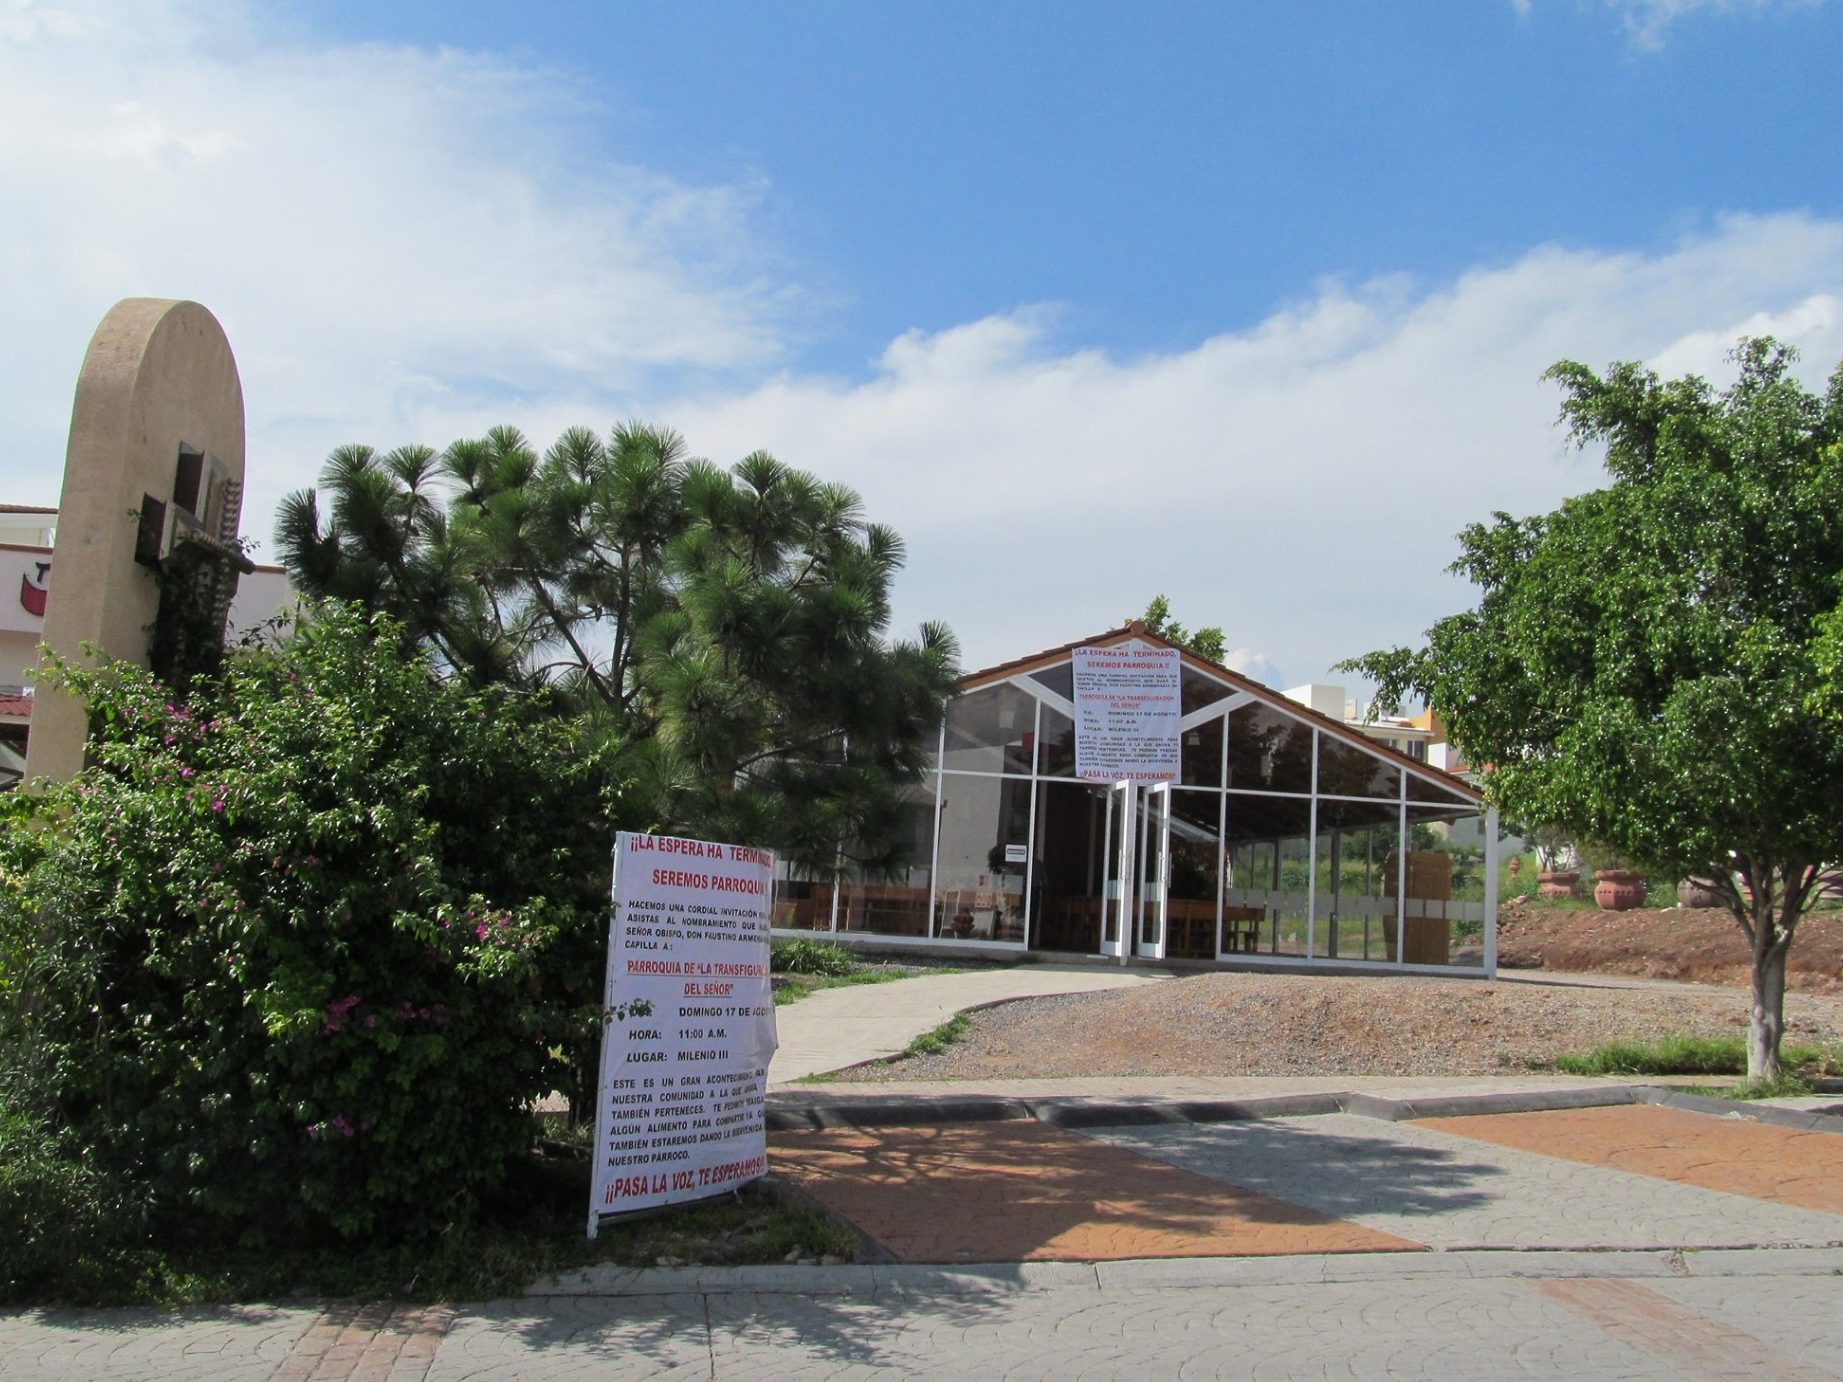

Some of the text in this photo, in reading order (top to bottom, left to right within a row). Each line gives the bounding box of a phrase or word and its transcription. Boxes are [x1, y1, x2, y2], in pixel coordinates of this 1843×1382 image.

[658, 837, 704, 857] ESPERA
[708, 844, 722, 859] HA
[652, 869, 708, 889] SEREMOS
[628, 900, 666, 911] HACEMOS
[669, 904, 685, 912] UNA
[687, 905, 718, 915] CORDIAL
[627, 913, 659, 924] ASISTAS
[666, 916, 676, 925] AL
[682, 917, 737, 928] NOMBRAMIENTO
[741, 921, 756, 930] QUE
[626, 926, 652, 936] SEÑOR
[687, 931, 702, 939] DON
[704, 932, 737, 941] FAUSTINO
[625, 940, 657, 950] CAPILLA
[627, 960, 681, 974] PARROQUIA
[684, 962, 695, 974] DE
[684, 983, 701, 995] DEL
[679, 1007, 722, 1017] DOMINGO
[725, 1007, 736, 1017] 17
[738, 1007, 750, 1017] DE
[629, 1028, 727, 1040] HORA: 11:00 A.M.
[627, 1049, 729, 1063] LUGAR: MILENIO III
[613, 1079, 636, 1089] ESTE
[643, 1078, 654, 1088] ES
[662, 1078, 673, 1087] UN
[680, 1076, 701, 1086] GRAN
[612, 1093, 653, 1105] NUESTRA
[660, 1090, 704, 1102] COMUNIDAD
[710, 1089, 715, 1098] A
[720, 1089, 728, 1098] LA
[713, 1103, 721, 1112] TE
[648, 1121, 688, 1133] ALIMENTO
[693, 1118, 711, 1129] PARA
[652, 1135, 697, 1148] ESTAREMOS
[700, 1131, 721, 1143] DANDO
[724, 1130, 730, 1140] LA
[608, 1154, 649, 1167] NUESTRO
[652, 1173, 667, 1194] LA
[672, 1170, 695, 1191] VOZ,
[698, 1167, 711, 1186] TE
